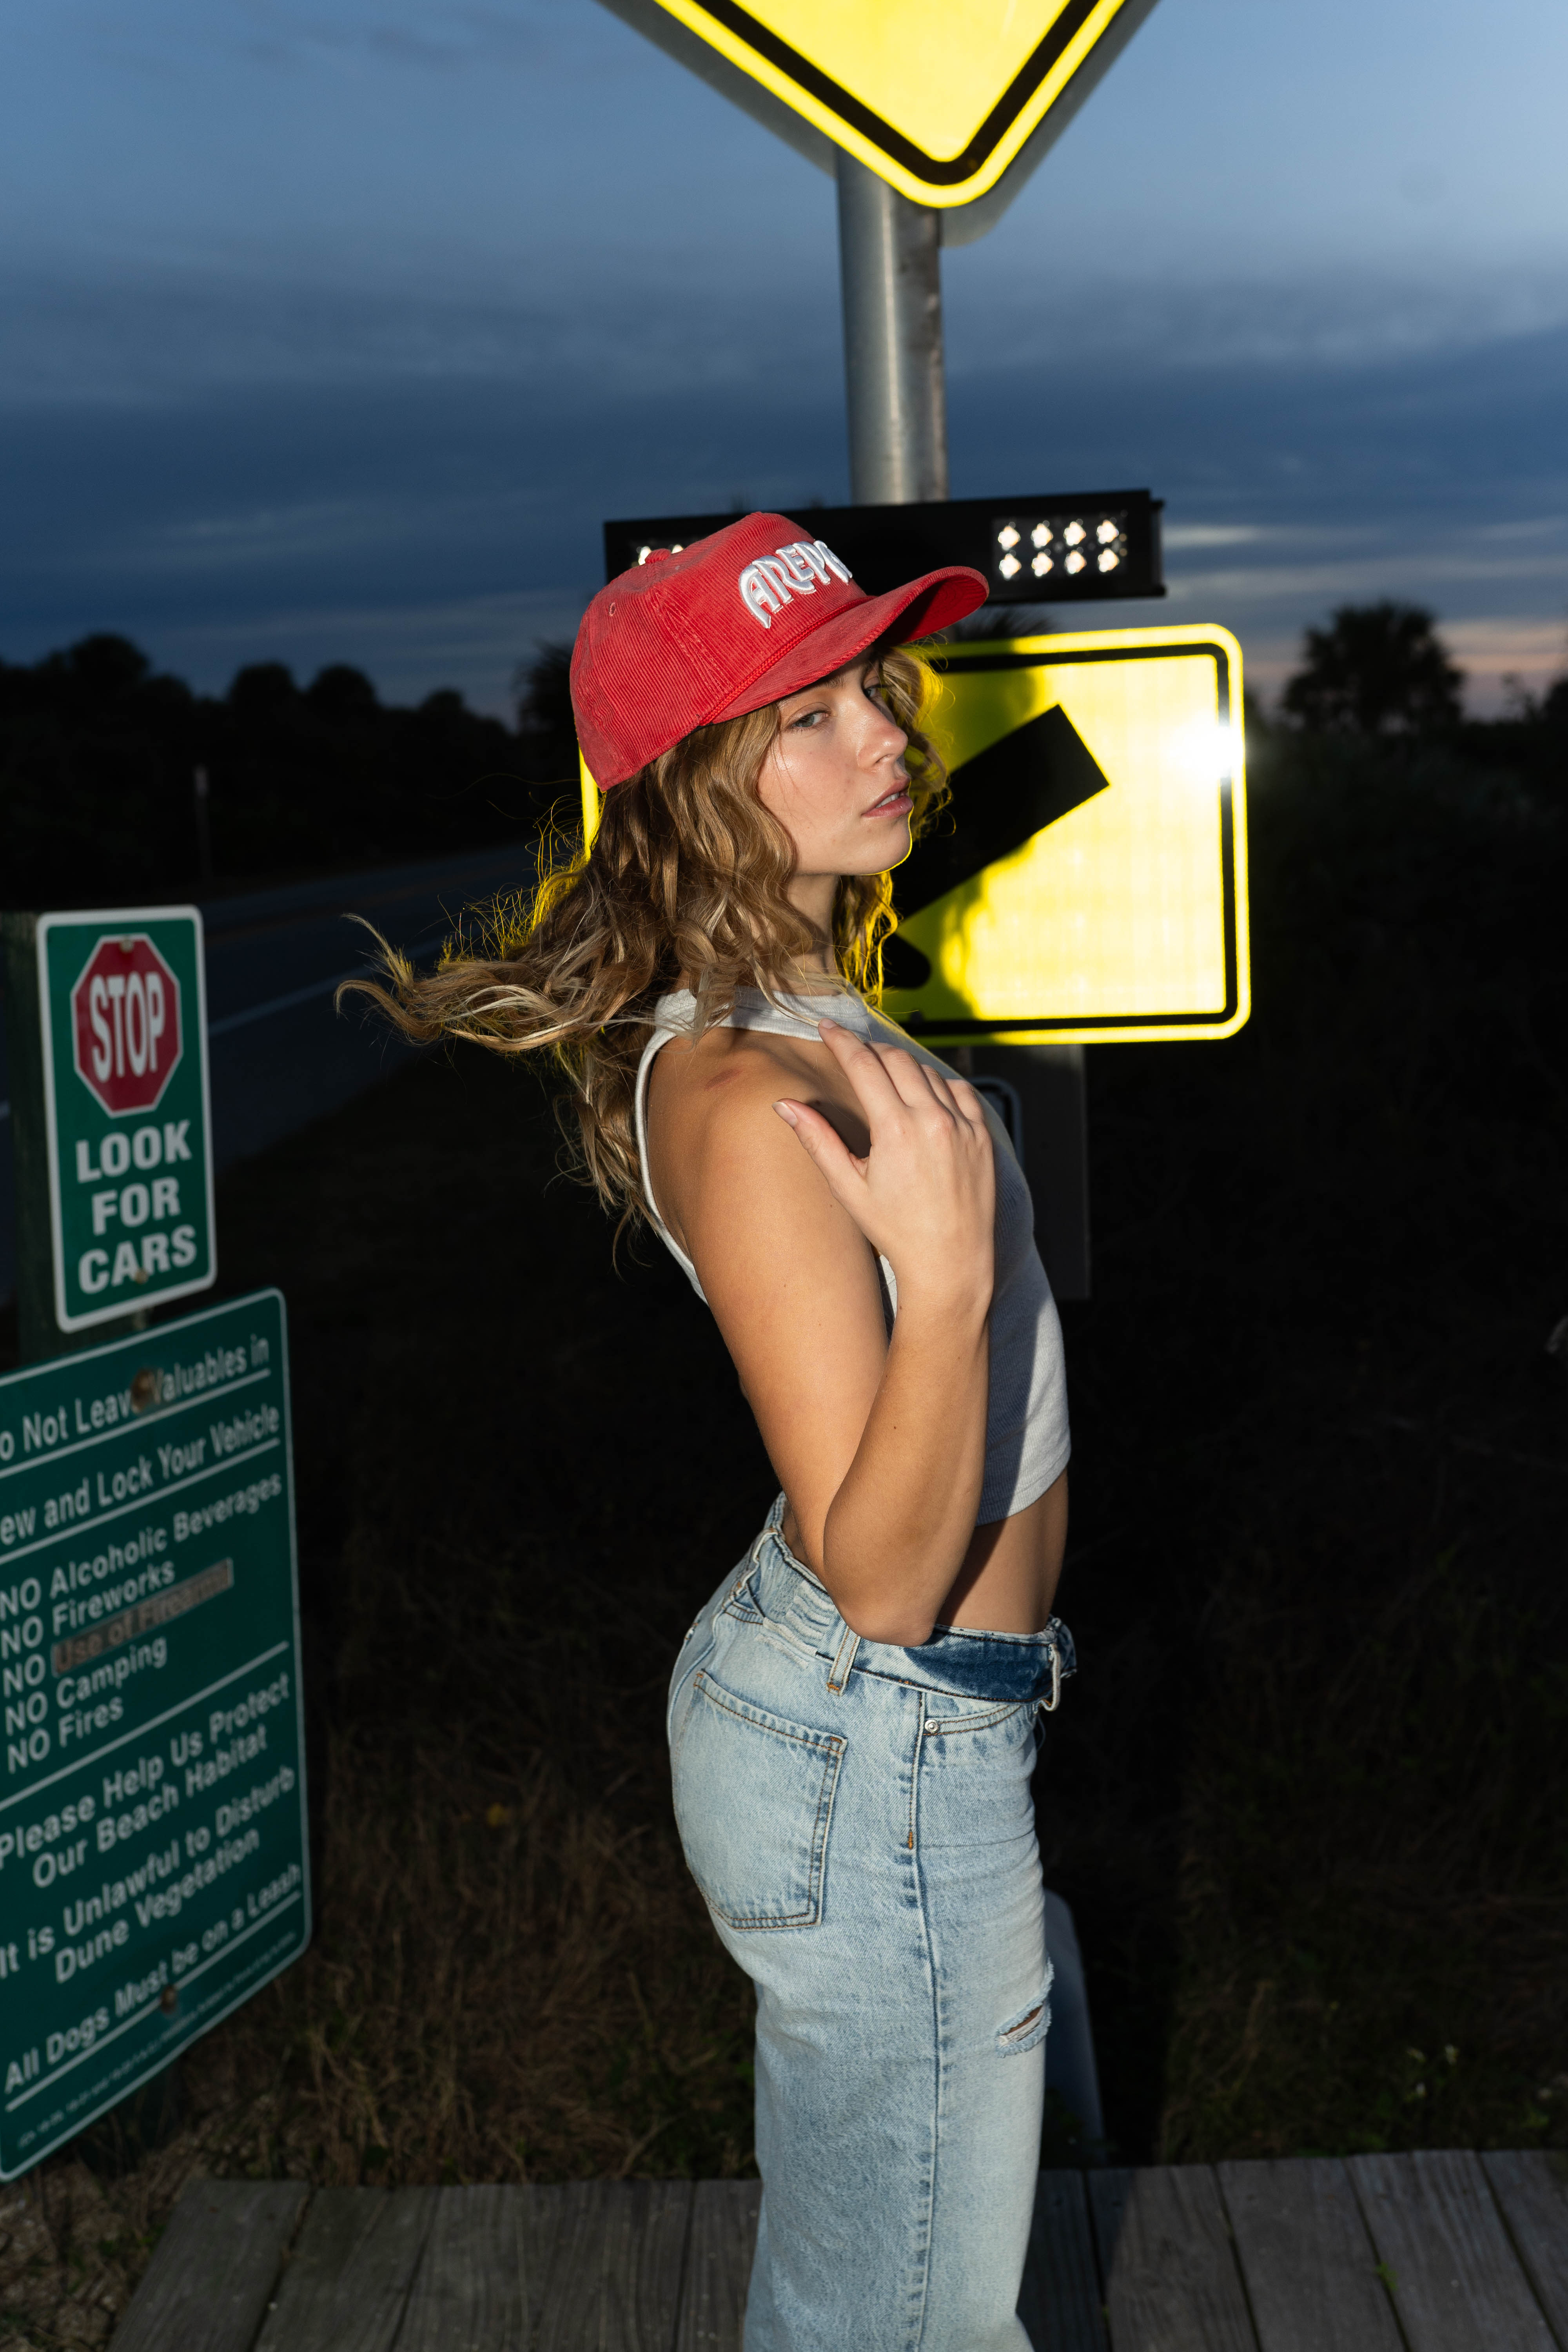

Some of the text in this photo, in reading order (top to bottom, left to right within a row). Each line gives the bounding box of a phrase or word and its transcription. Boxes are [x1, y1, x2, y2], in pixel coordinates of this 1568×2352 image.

[89, 971, 164, 1083] STOP
[76, 1120, 191, 1183] LOOK
[92, 1177, 181, 1236] FOR
[78, 1225, 197, 1294] CARS
[0, 1431, 15, 1461] o
[22, 1406, 68, 1451] Not
[75, 1390, 137, 1434] Leav
[250, 1334, 270, 1365] in
[0, 1403, 279, 1545] ew and Lock Your Vehicle
[0, 1474, 282, 1621] NO Alcoholic Beverages
[1, 1561, 175, 1659] NO Fireworks
[3, 1575, 227, 1698] NO Use of Firea
[5, 1637, 167, 1736] NO Camping
[0, 1672, 290, 1870] Please Help Us Protect
[7, 1697, 123, 1774] NO Fires
[33, 1724, 267, 1888] Our Beach Habitat
[0, 1765, 295, 1979] It is Unlawful to Disturb
[55, 1828, 260, 1984] Dune Vegetation
[4, 1862, 301, 2095] All Dogs Must be on a Leash
